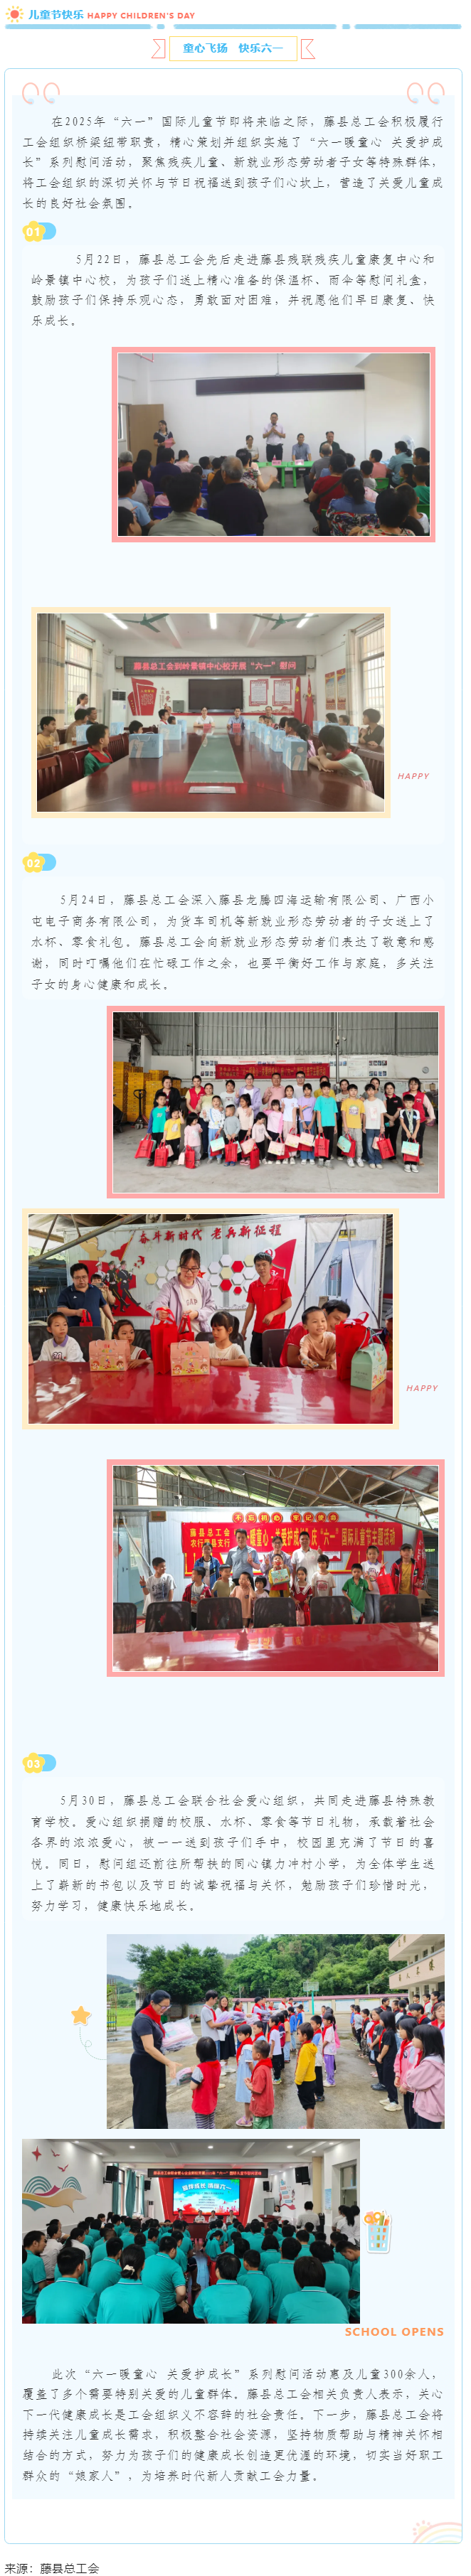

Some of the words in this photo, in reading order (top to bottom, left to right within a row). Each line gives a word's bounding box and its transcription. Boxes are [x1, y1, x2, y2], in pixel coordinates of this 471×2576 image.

[139, 1228, 203, 1244] 奋斗新时代
[211, 1224, 282, 1240] 老兵新征程
[190, 1528, 231, 1537] 藤县总工会
